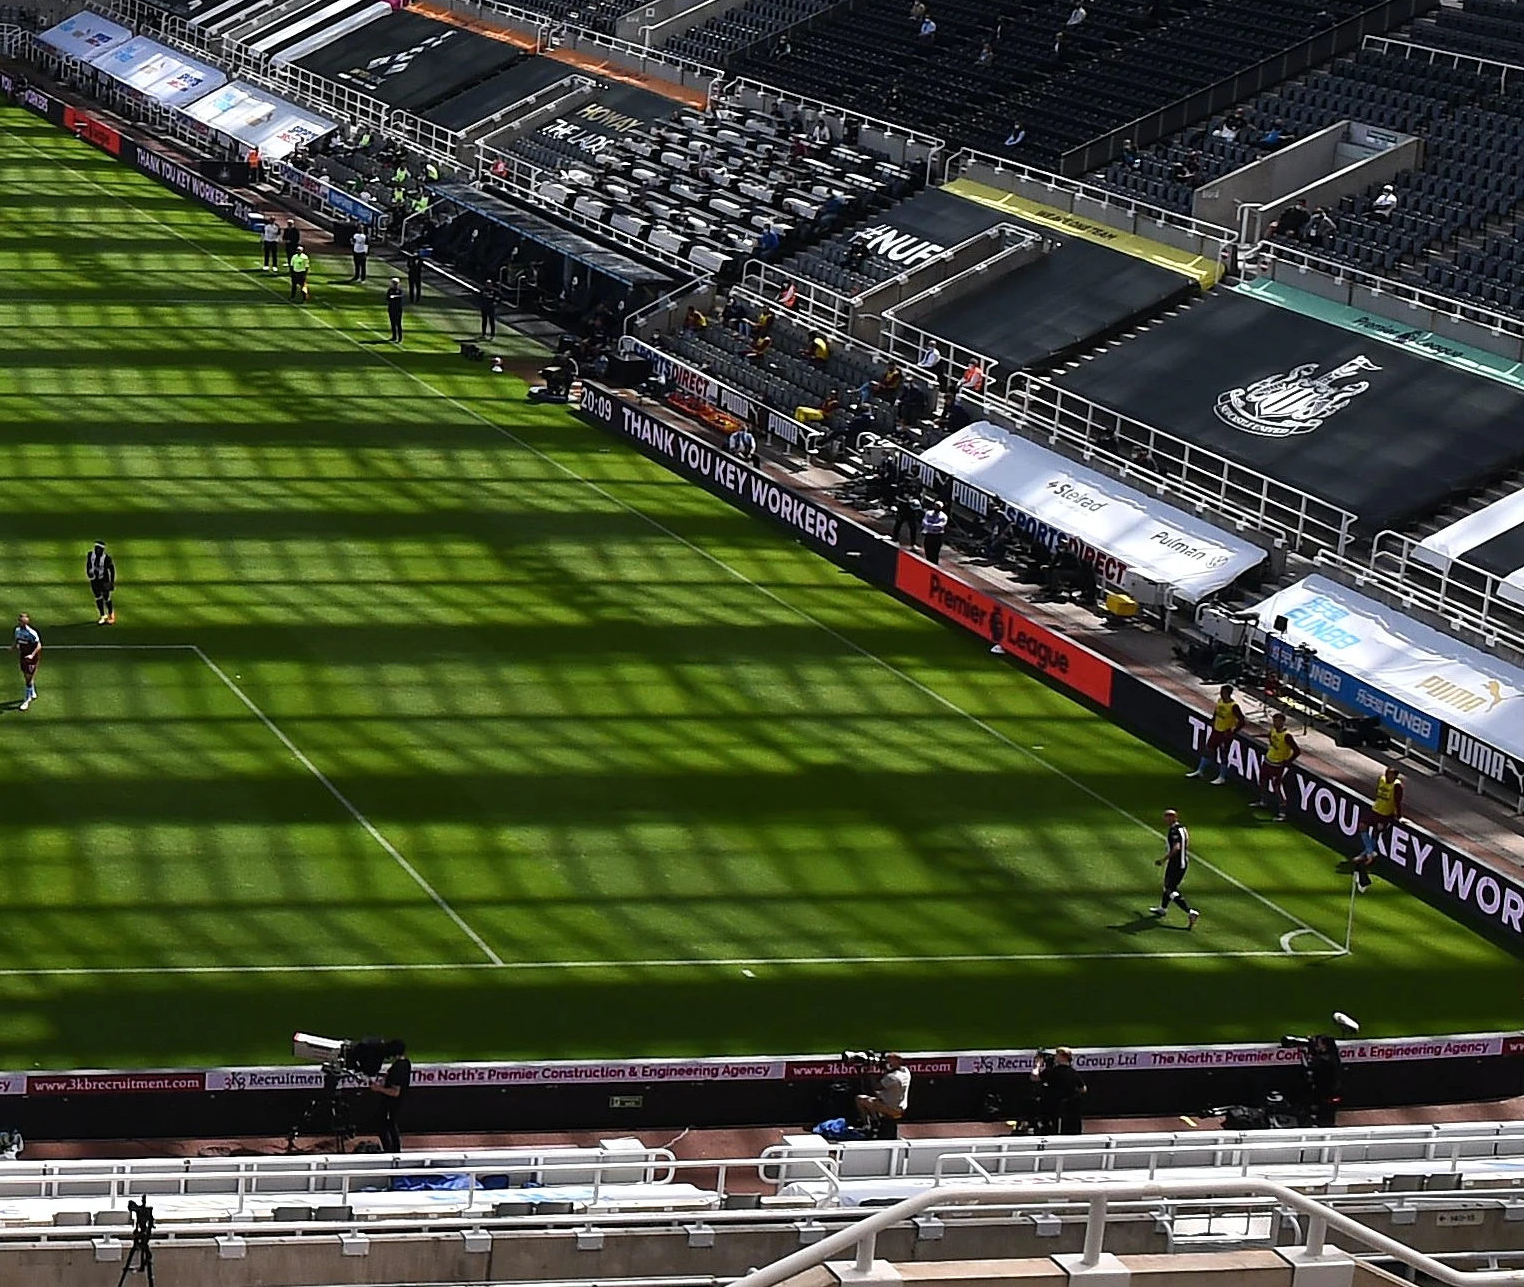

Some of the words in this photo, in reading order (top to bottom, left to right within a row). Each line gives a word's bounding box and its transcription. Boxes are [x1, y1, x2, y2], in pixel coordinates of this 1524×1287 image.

[576, 103, 644, 133] HOWAY
[136, 147, 160, 174] THANK
[160, 160, 177, 184] YOU
[177, 169, 192, 190] KEY
[191, 174, 230, 206] WORKERS
[581, 387, 612, 421] 20:09
[622, 407, 674, 458] THANK
[678, 437, 711, 476] YOU
[715, 454, 748, 495] KEY
[750, 475, 838, 547] WORKERS
[1151, 530, 1208, 563] Pulman
[929, 571, 986, 638] Premier
[1006, 621, 1070, 675] League
[1284, 607, 1361, 650] FUN88
[1414, 674, 1487, 712] PUMA
[1446, 727, 1506, 783] PUMA
[1296, 773, 1360, 836] YOU
[411, 1070, 436, 1083] The
[438, 1068, 485, 1082] North's
[488, 1067, 539, 1081] Premier
[542, 1065, 624, 1080] Construction
[629, 1065, 639, 1078] &
[642, 1064, 719, 1080] Engineering
[722, 1063, 771, 1078] Agency
[1077, 1055, 1114, 1070] Group
[1118, 1054, 1138, 1066] Ltd
[1151, 1053, 1176, 1066] The
[1178, 1051, 1222, 1065] North's
[1226, 1049, 1273, 1063] Premier
[1357, 1047, 1366, 1059] &
[1370, 1043, 1441, 1059] Engineering
[1444, 1041, 1489, 1057] Agency
[35, 1076, 199, 1092] www.3kbrecruitment.com
